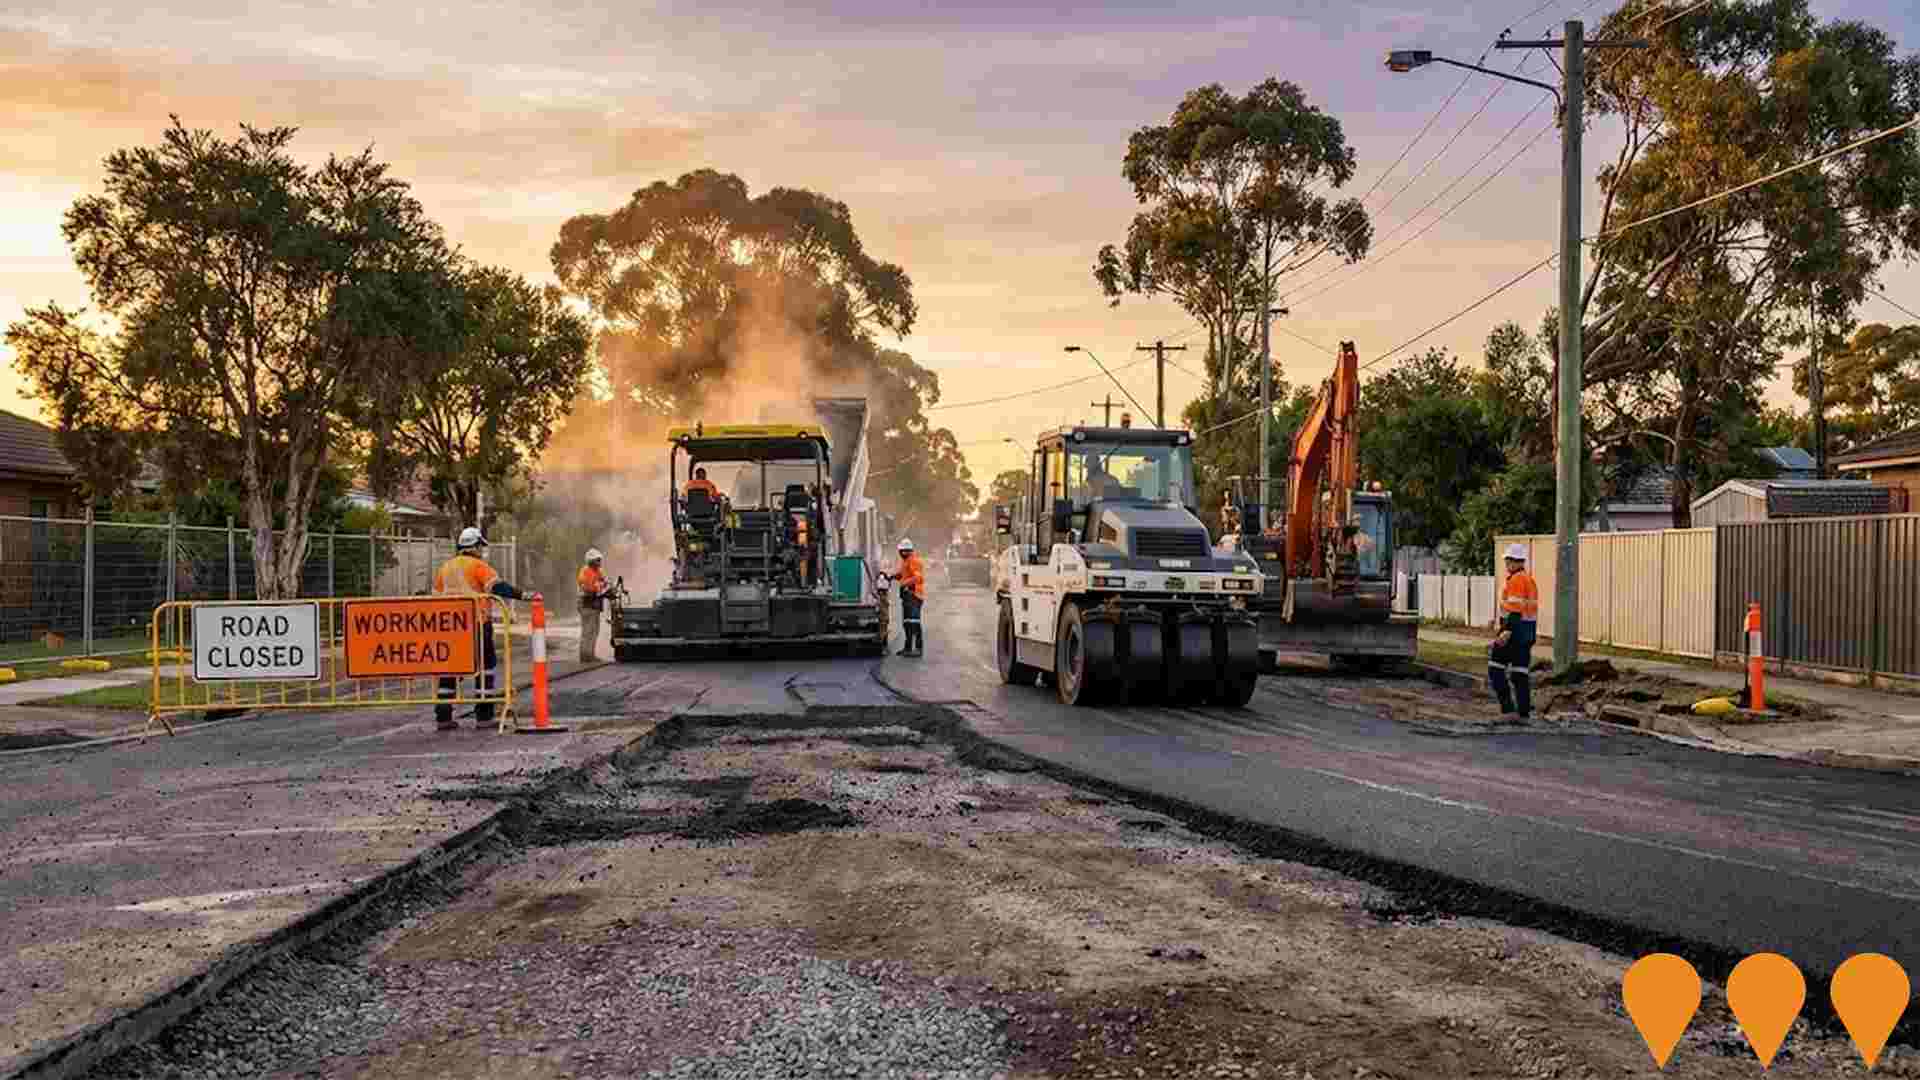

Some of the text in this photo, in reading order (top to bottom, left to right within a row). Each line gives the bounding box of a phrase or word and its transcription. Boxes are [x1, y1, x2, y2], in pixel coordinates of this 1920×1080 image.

[221, 615, 289, 637] ROAD
[352, 611, 468, 635] WORKMEN
[208, 646, 304, 668] CLOSED
[371, 641, 450, 665] AHEAD
